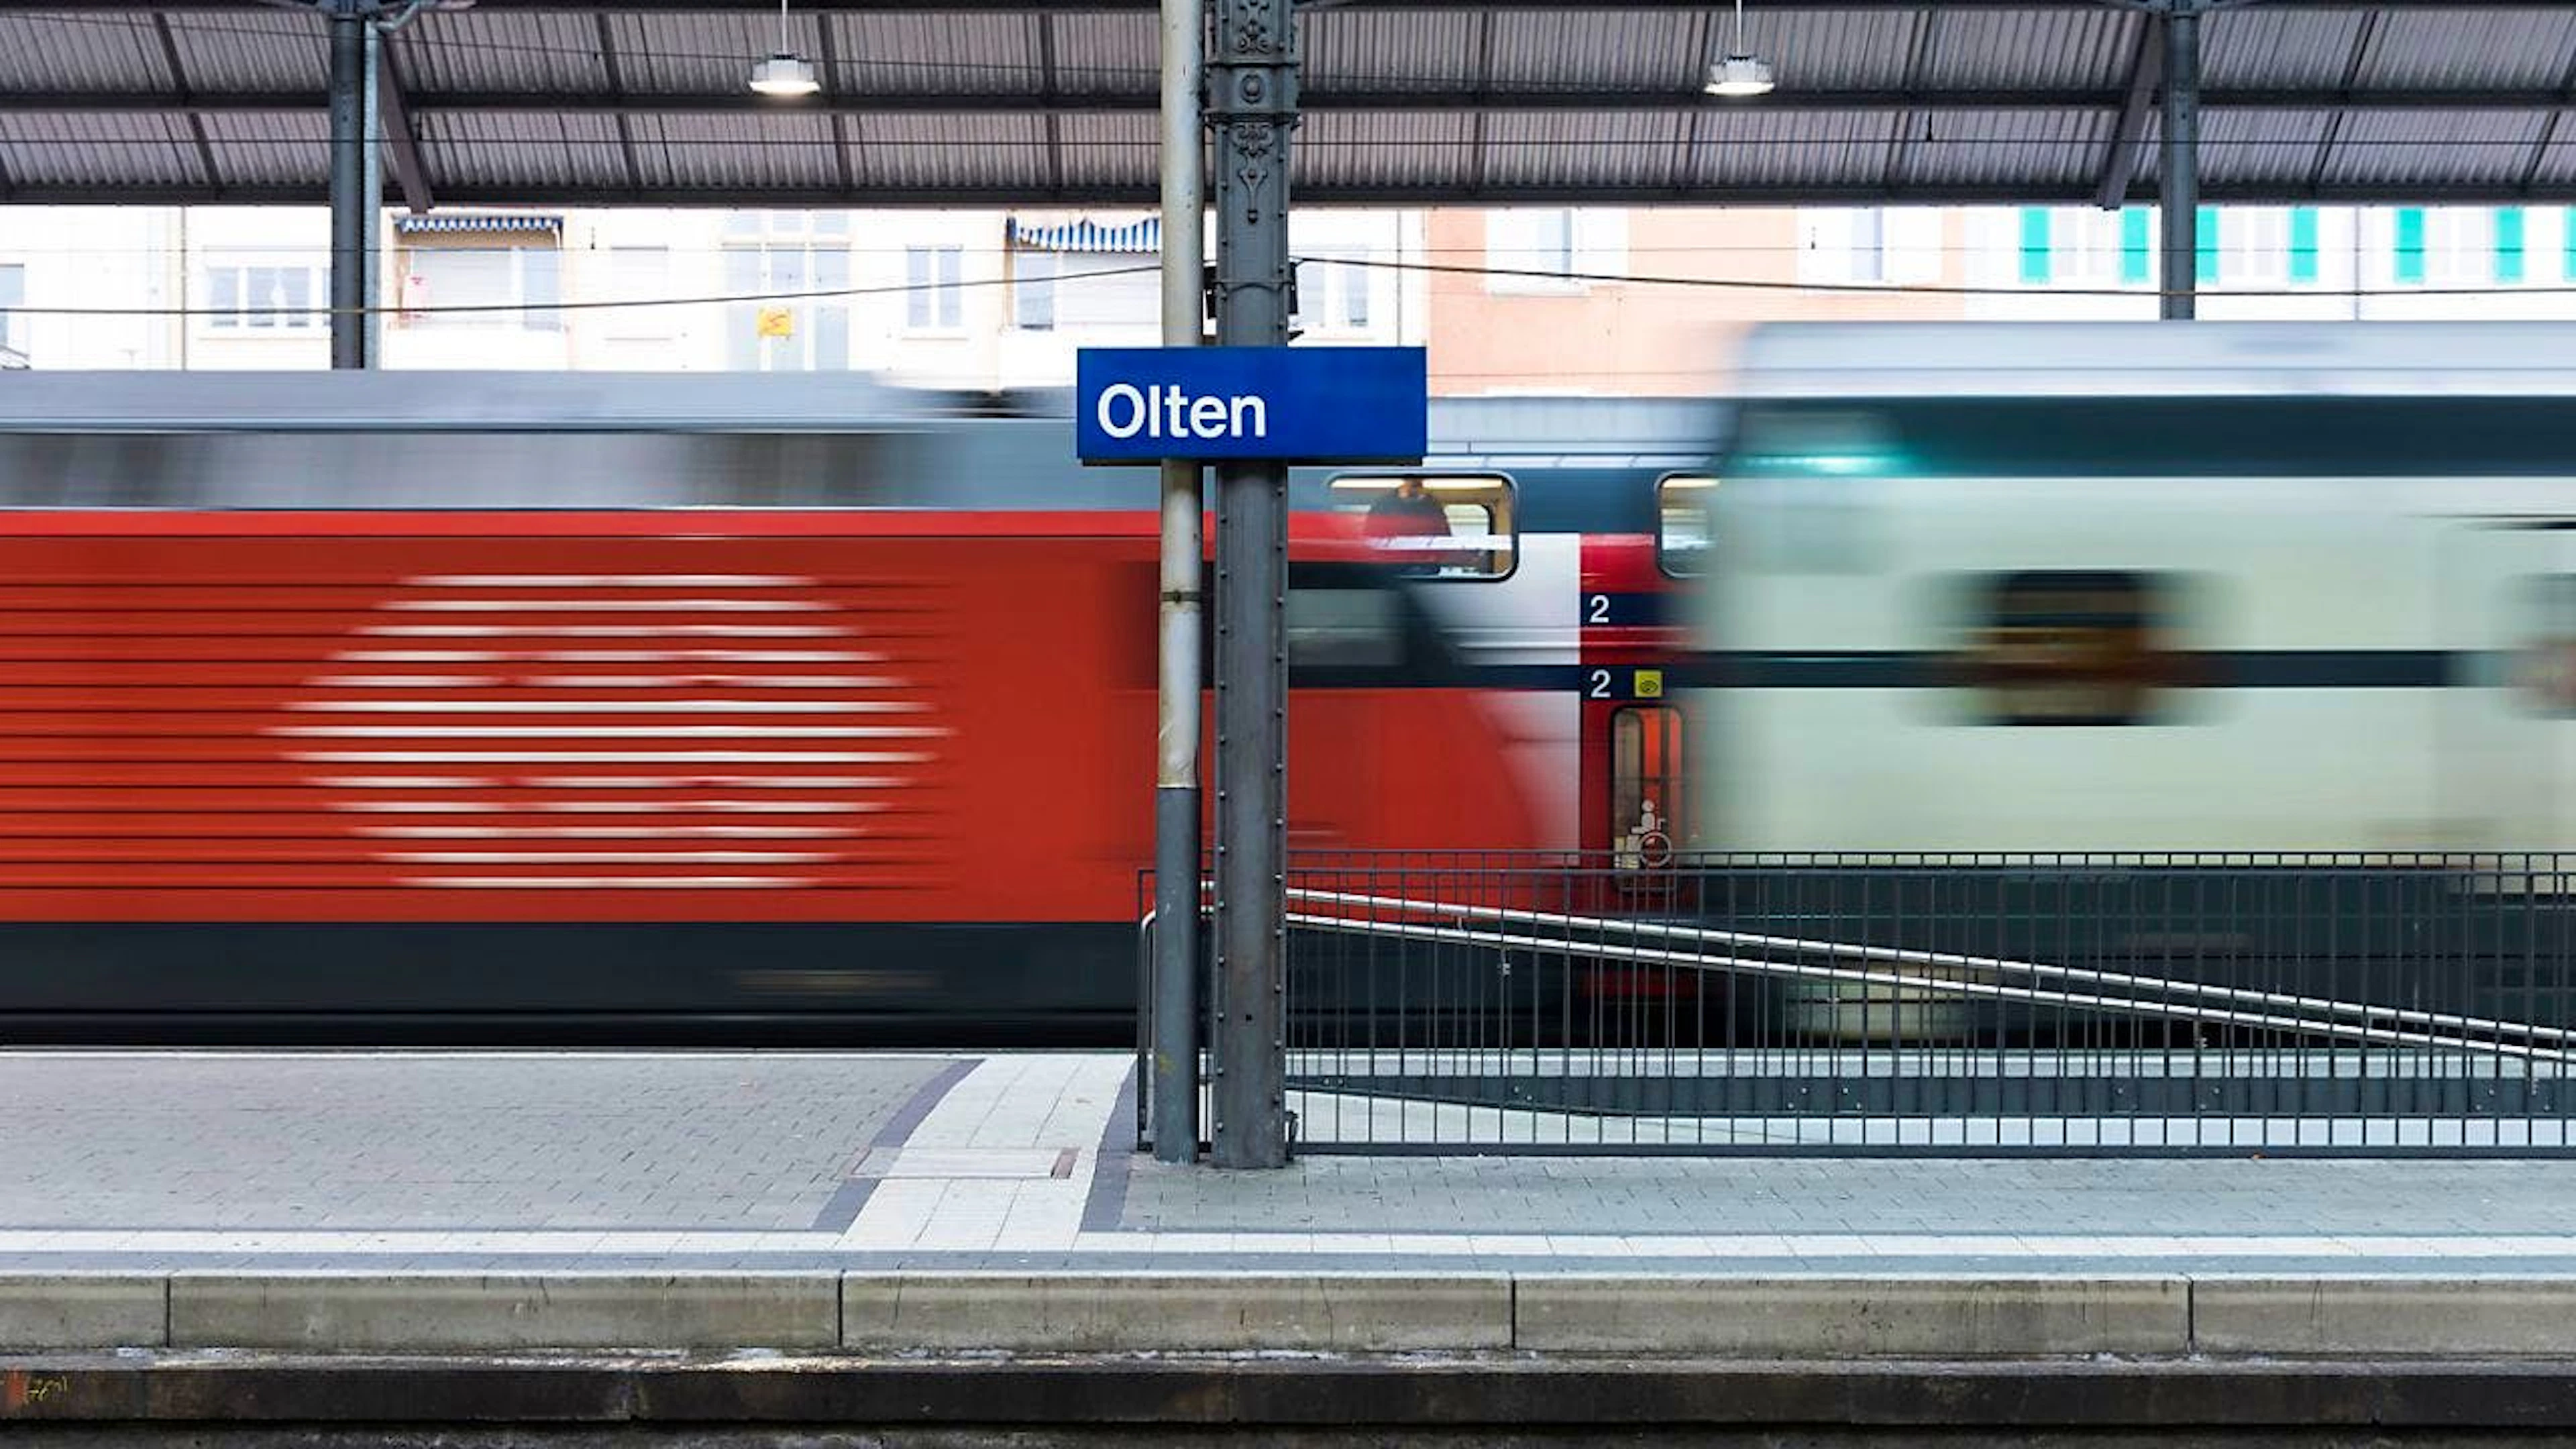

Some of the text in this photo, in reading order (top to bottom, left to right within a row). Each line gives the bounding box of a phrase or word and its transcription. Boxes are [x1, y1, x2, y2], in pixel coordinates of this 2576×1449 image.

[1097, 383, 1266, 438] Olten
[1590, 594, 1609, 623] 2
[1591, 669, 1611, 698] 2
